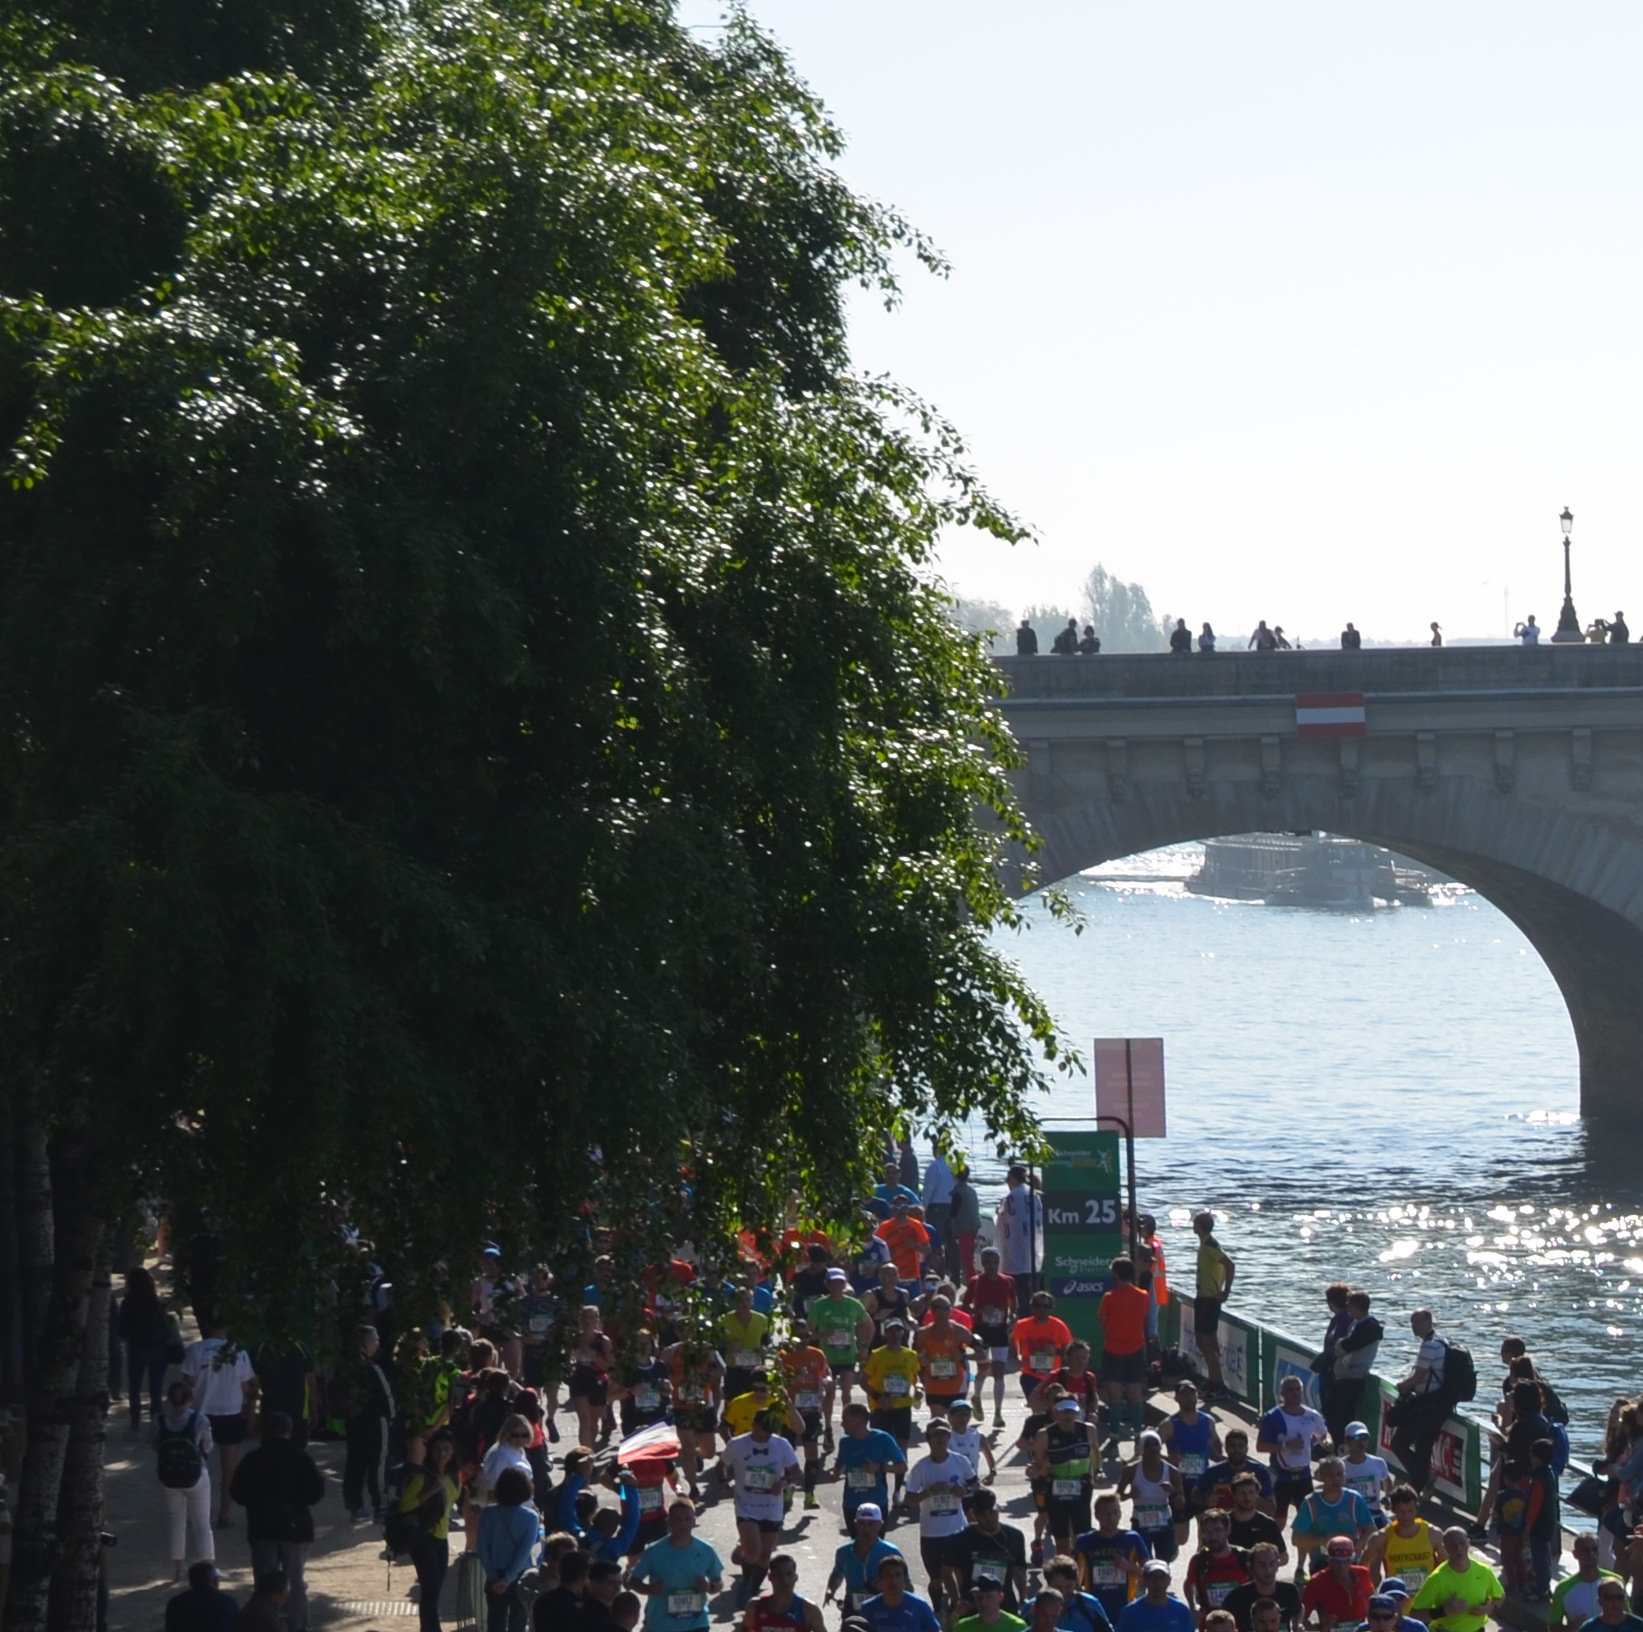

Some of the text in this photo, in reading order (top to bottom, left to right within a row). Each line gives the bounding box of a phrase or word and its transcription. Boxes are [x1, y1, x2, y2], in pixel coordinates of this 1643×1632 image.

[1048, 1208, 1079, 1224] Km
[1085, 1199, 1116, 1224] 25
[1055, 1256, 1111, 1273] Schneider
[1076, 1280, 1104, 1293] asics
